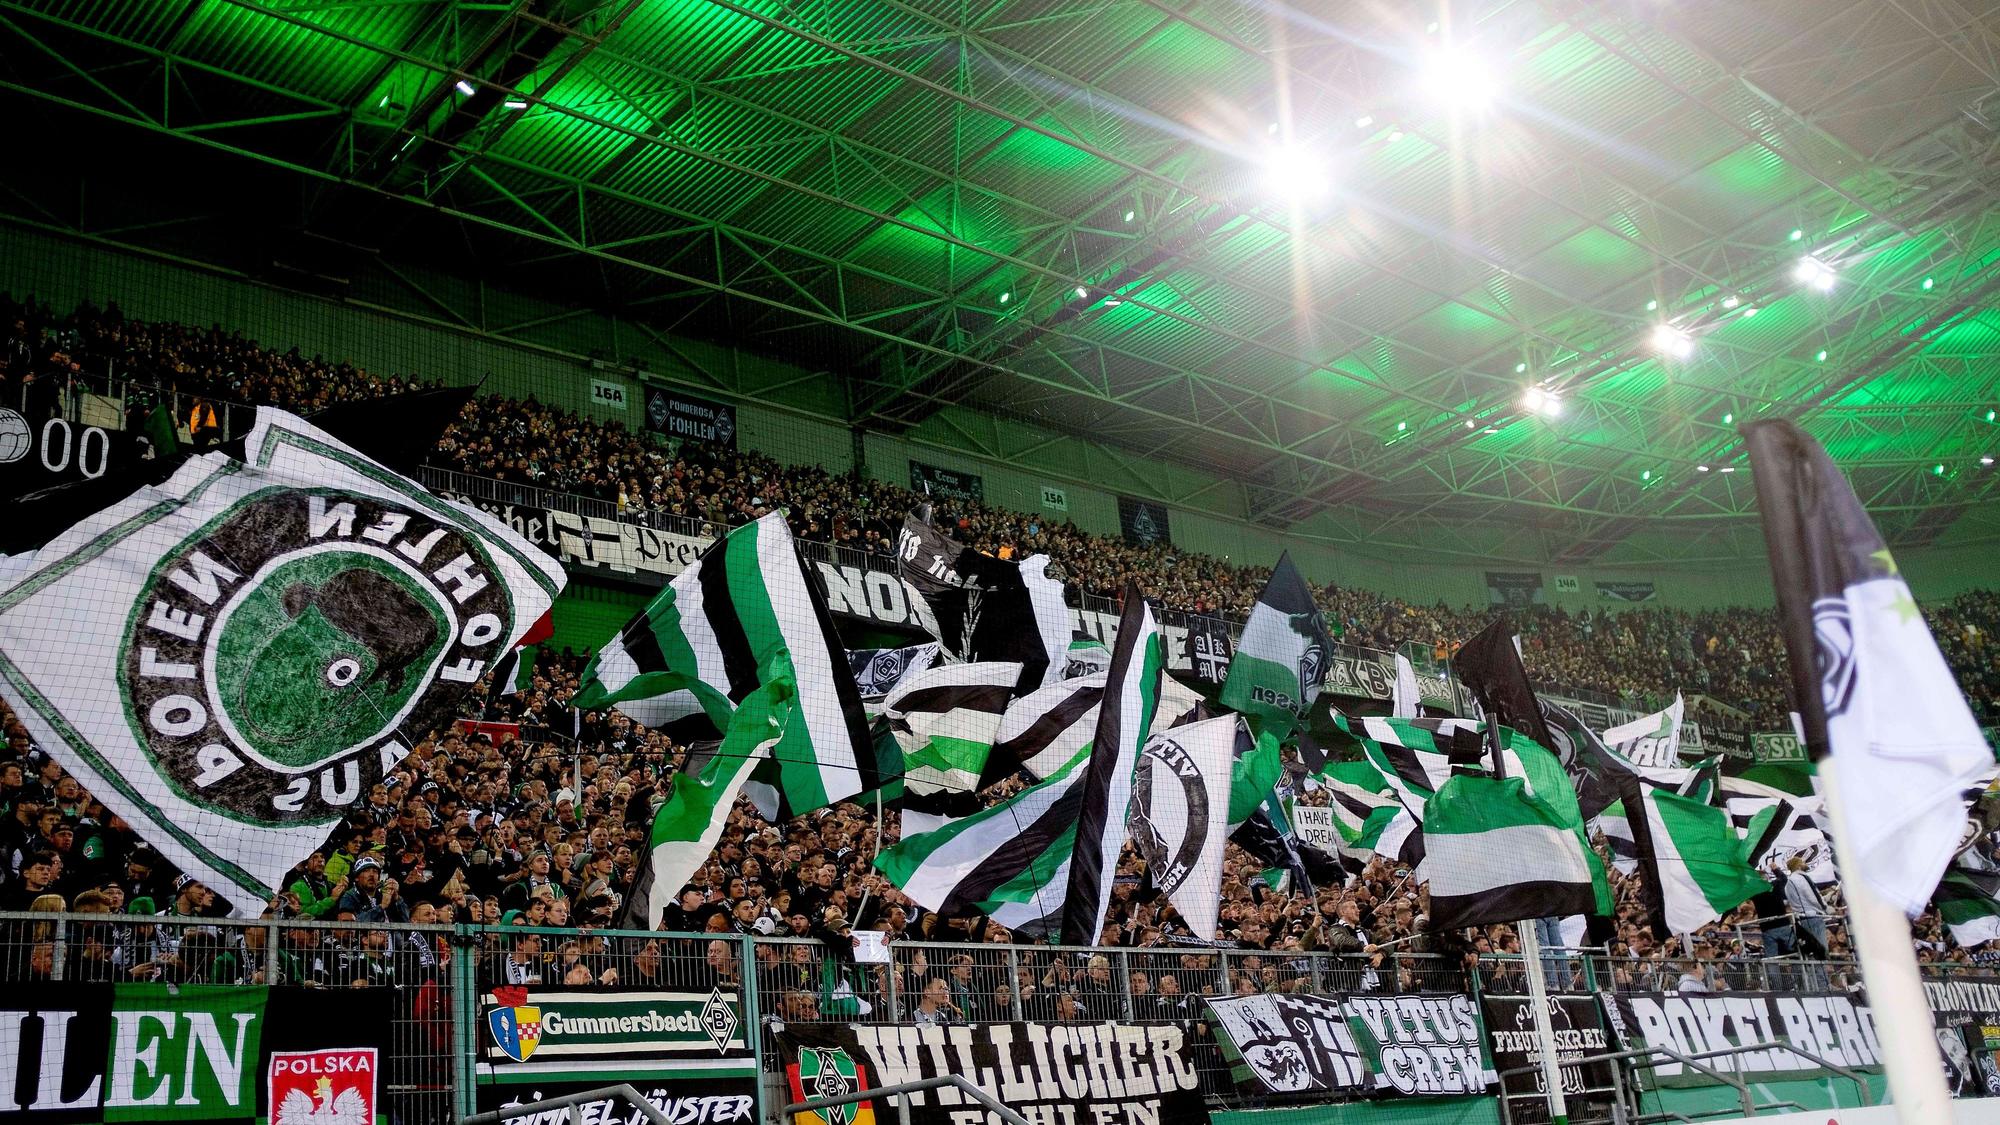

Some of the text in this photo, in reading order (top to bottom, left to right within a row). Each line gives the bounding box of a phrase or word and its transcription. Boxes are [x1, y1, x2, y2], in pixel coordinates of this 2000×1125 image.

[595, 385, 622, 402] 16A
[669, 400, 714, 420] PONDEROSA
[669, 416, 715, 441] FOHLEN
[1044, 491, 1064, 505] 15A
[1557, 578, 1577, 589] 14A
[1298, 811, 1329, 826] I HAVE
[541, 1010, 702, 1034] Gummersbach
[1349, 994, 1480, 1045] VITUS
[1491, 1028, 1607, 1053] FREUNSKREI
[274, 1056, 371, 1076] POLSKA
[855, 1024, 1198, 1106] WILLICHER
[1380, 1045, 1487, 1095] CREW
